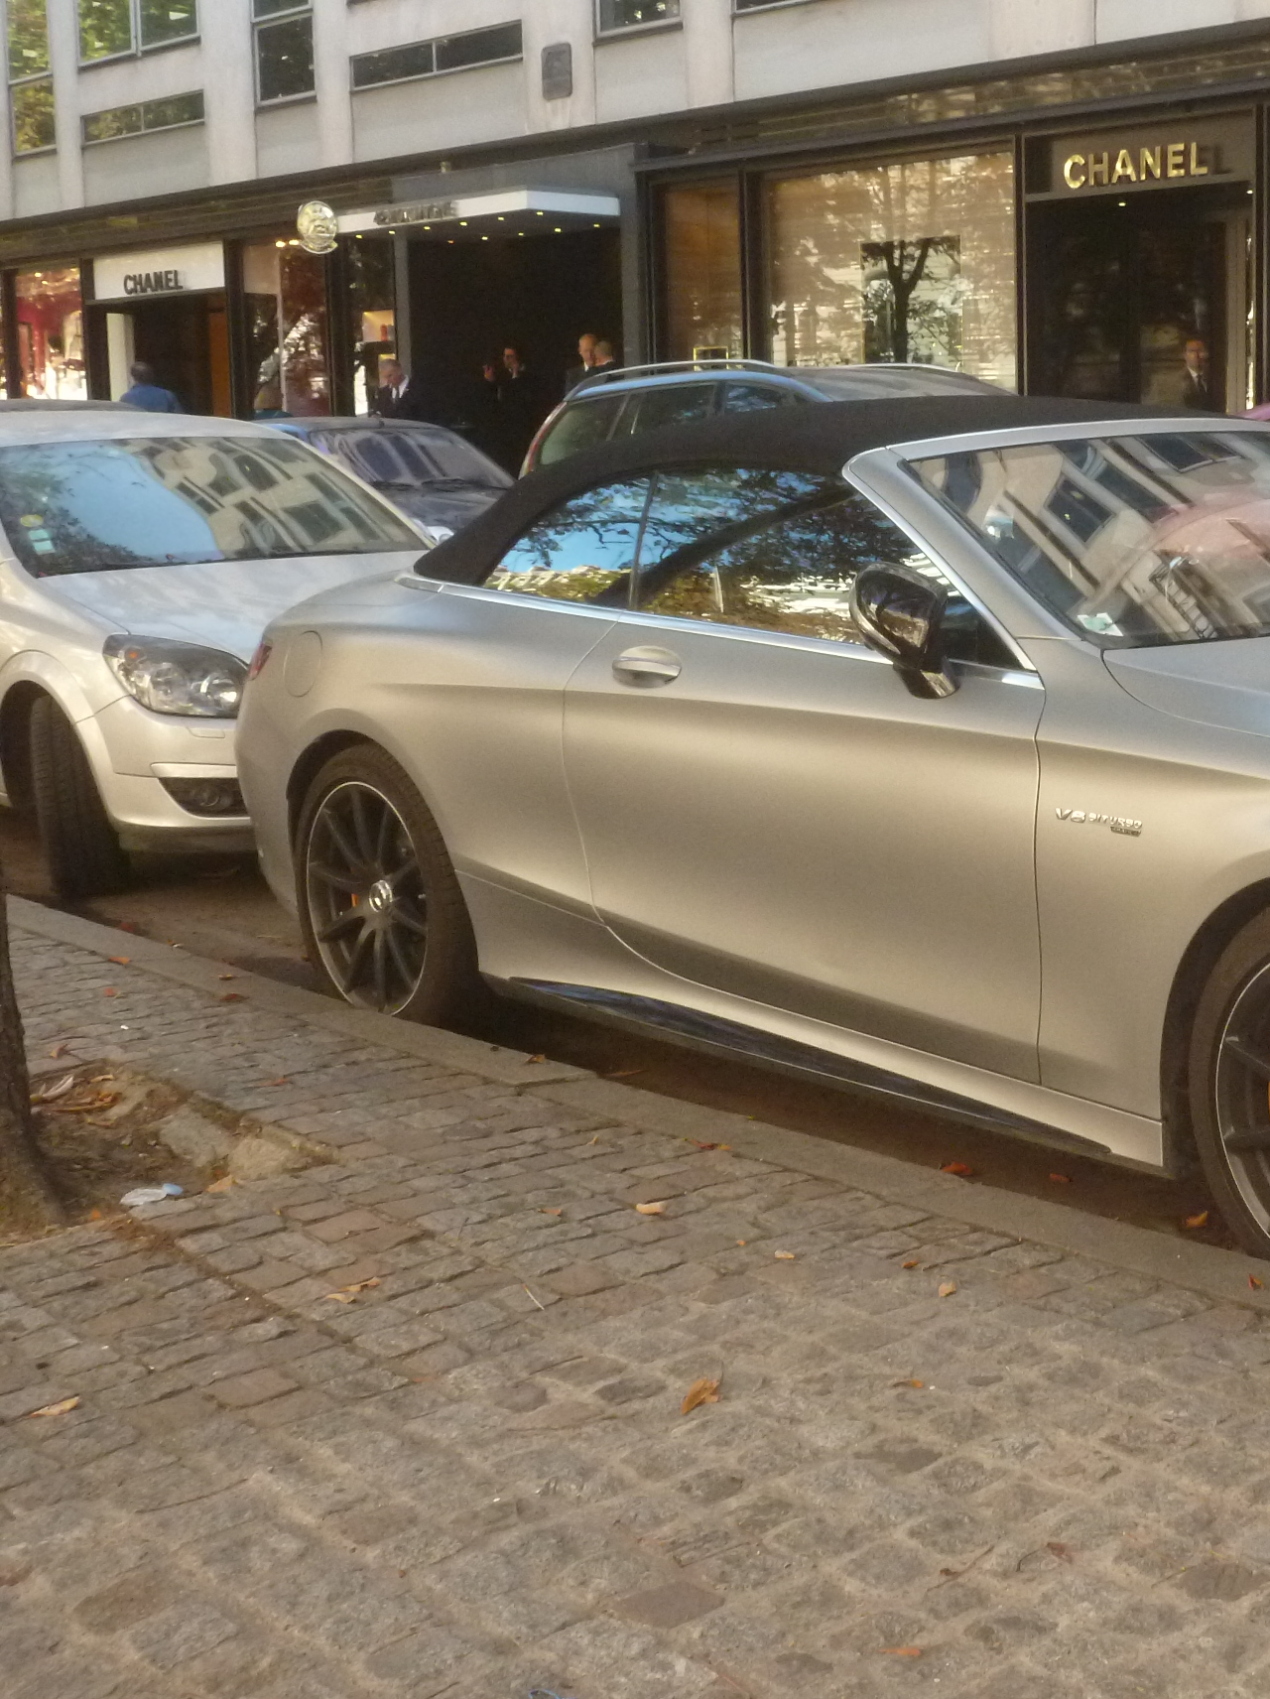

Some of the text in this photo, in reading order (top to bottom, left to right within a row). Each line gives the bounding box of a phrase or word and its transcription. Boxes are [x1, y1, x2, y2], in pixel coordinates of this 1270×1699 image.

[1063, 142, 1208, 189] CHANEL
[123, 269, 183, 295] CHANEL
[1055, 808, 1086, 823] V8
